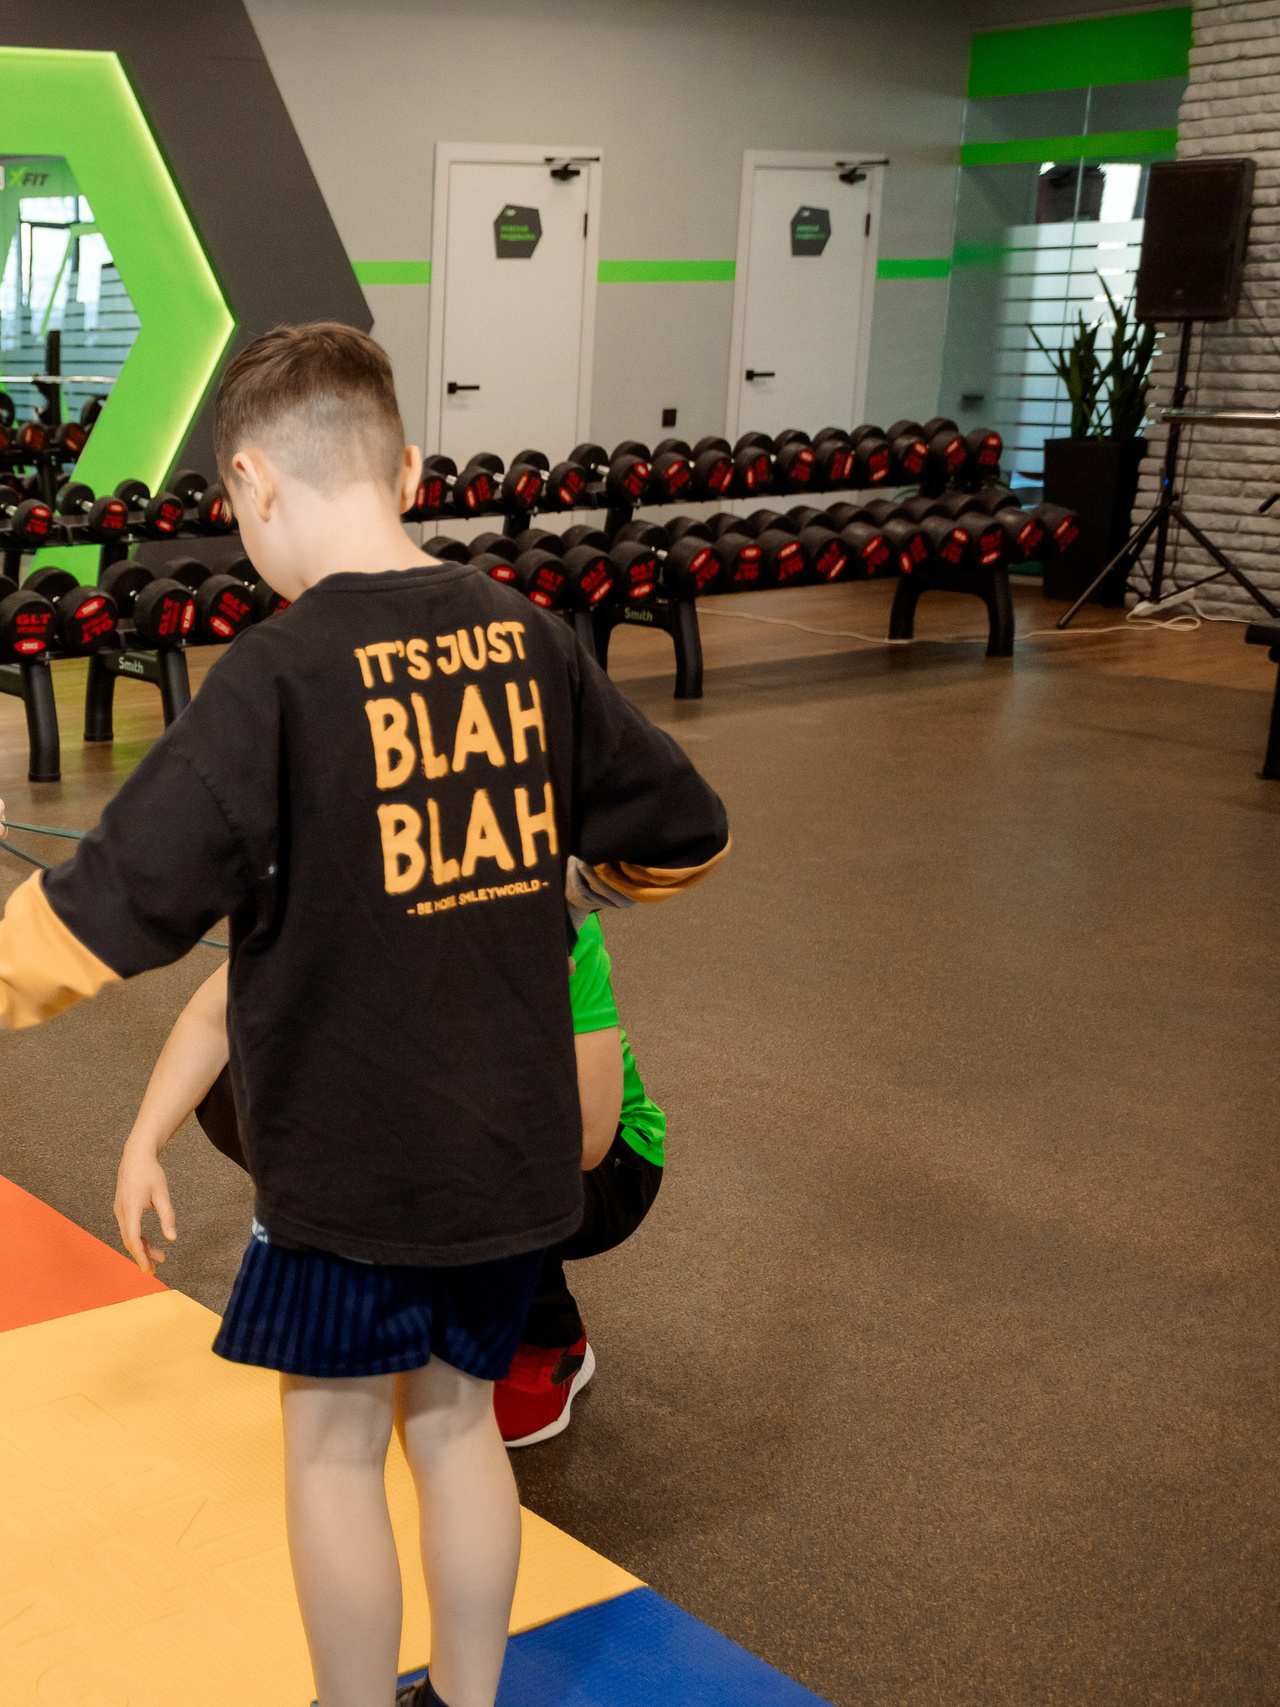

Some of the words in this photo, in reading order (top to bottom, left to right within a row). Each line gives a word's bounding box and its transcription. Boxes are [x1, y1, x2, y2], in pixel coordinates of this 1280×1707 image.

[9, 166, 49, 186] XFIT
[16, 613, 51, 625] GLT
[624, 606, 653, 622] Smith
[354, 638, 431, 688] IT'S
[436, 621, 525, 675] JUST
[118, 656, 144, 675] Smith
[365, 680, 546, 790] BLAH
[377, 782, 558, 895] BLAH
